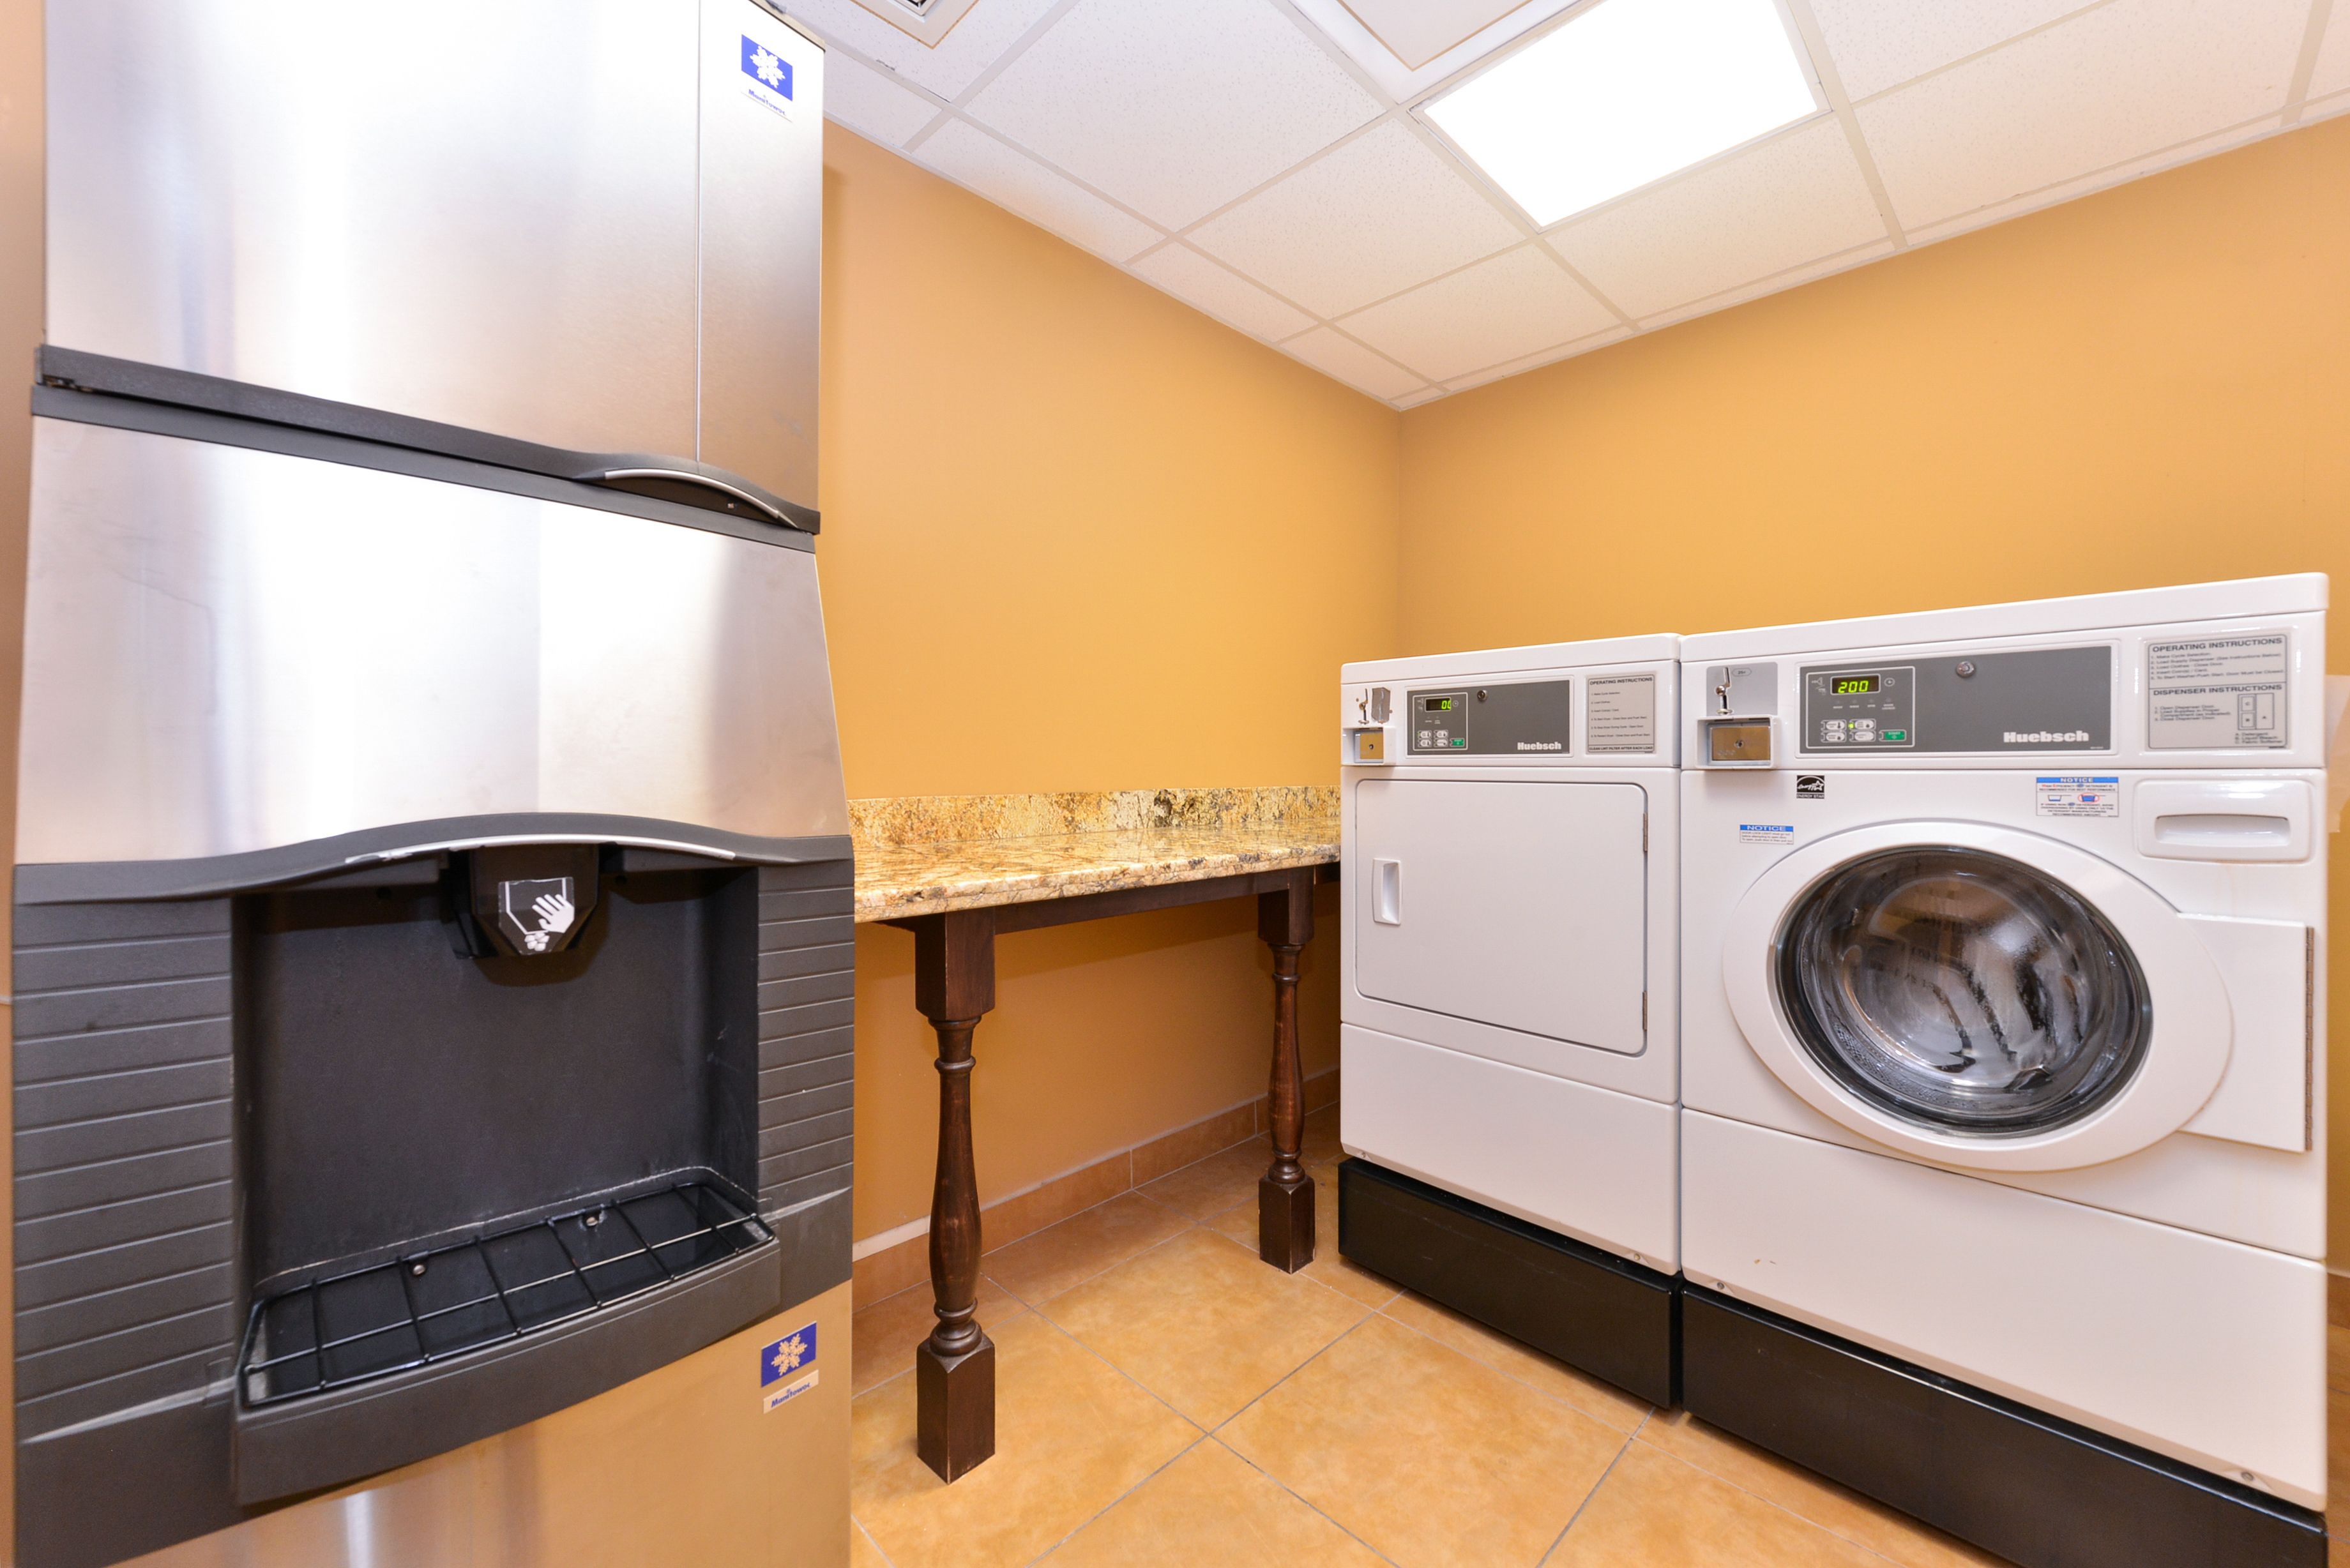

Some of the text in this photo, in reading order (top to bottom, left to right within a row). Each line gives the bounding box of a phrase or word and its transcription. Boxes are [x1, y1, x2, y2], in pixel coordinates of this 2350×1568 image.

[2153, 638, 2282, 652] OPERATING INSTRUCTIONS
[1838, 681, 1869, 693] 200
[2153, 684, 2282, 696] DISPENSER INSTRUCTIONS
[2003, 730, 2089, 743] Huebsch
[1517, 741, 1562, 750] Huebsch
